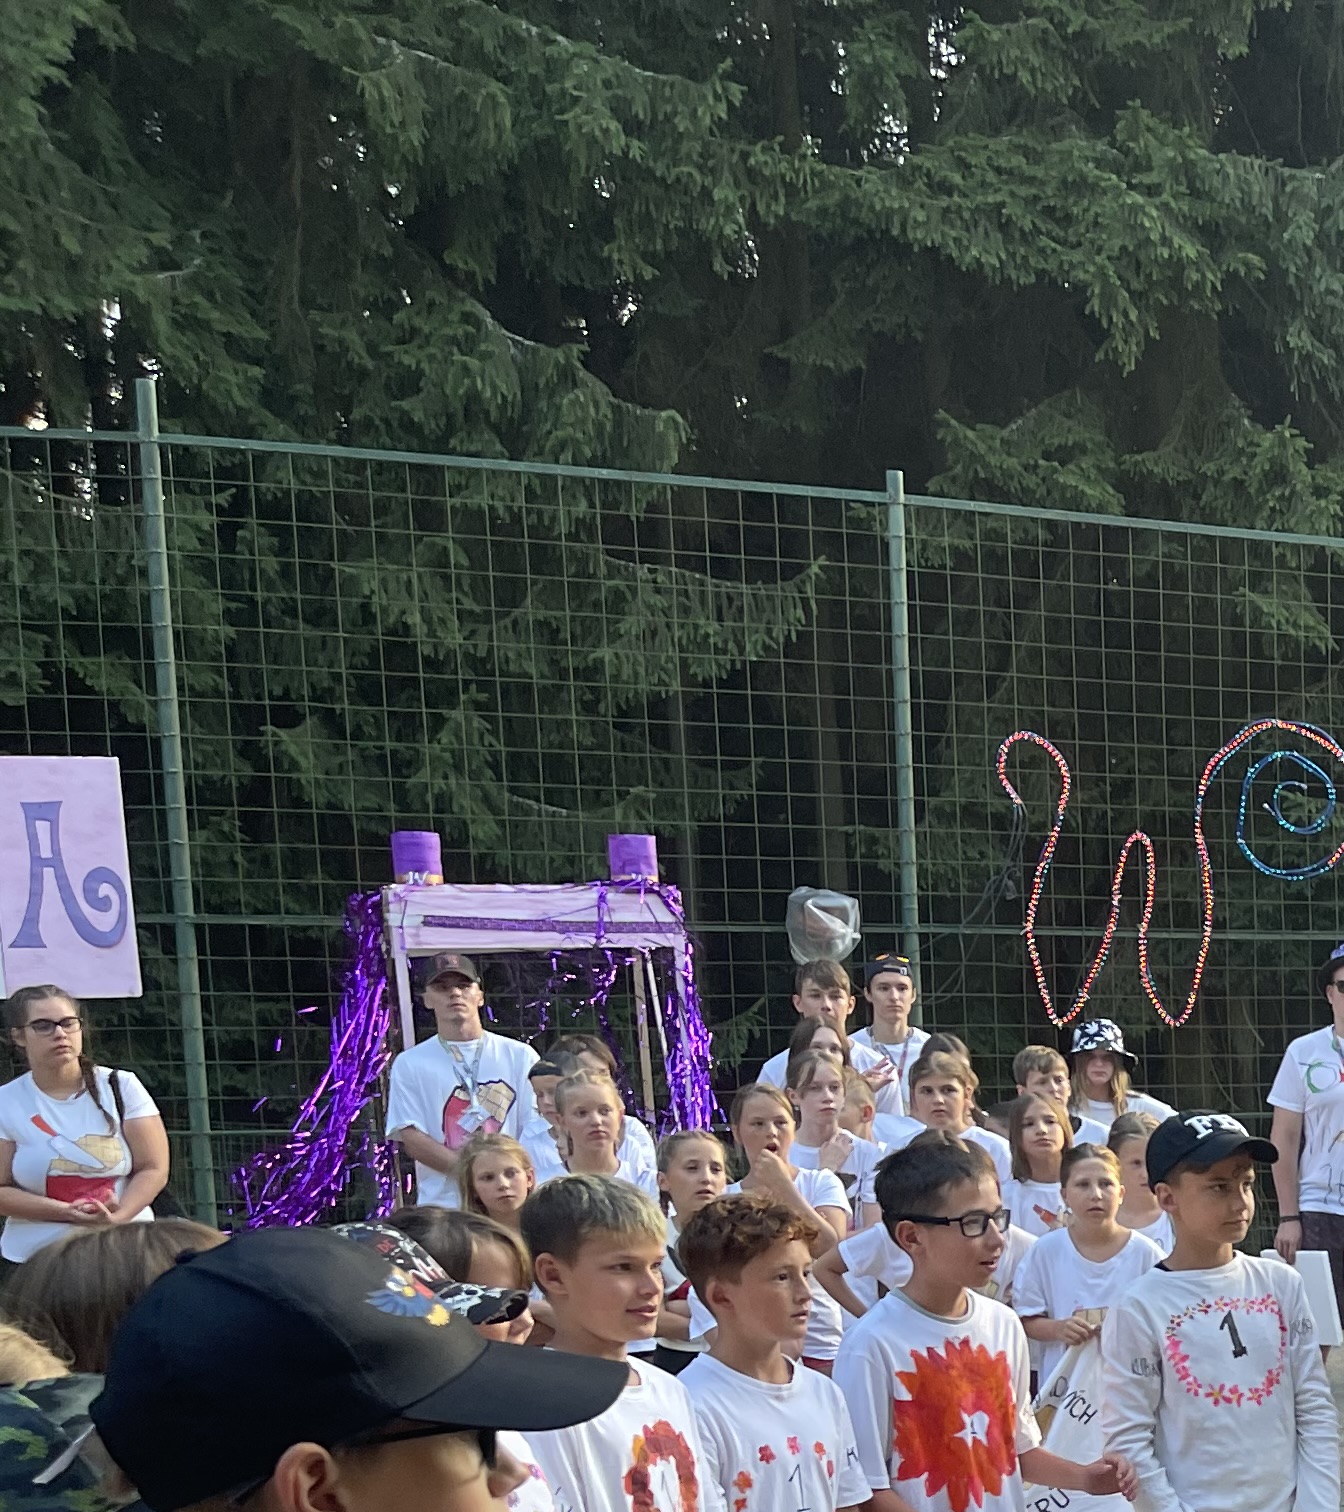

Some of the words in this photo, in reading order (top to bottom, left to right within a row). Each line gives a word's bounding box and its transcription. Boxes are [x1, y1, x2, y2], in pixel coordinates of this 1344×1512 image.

[9, 800, 128, 949] A
[1219, 1310, 1249, 1359] 1
[788, 1463, 812, 1512] 1
